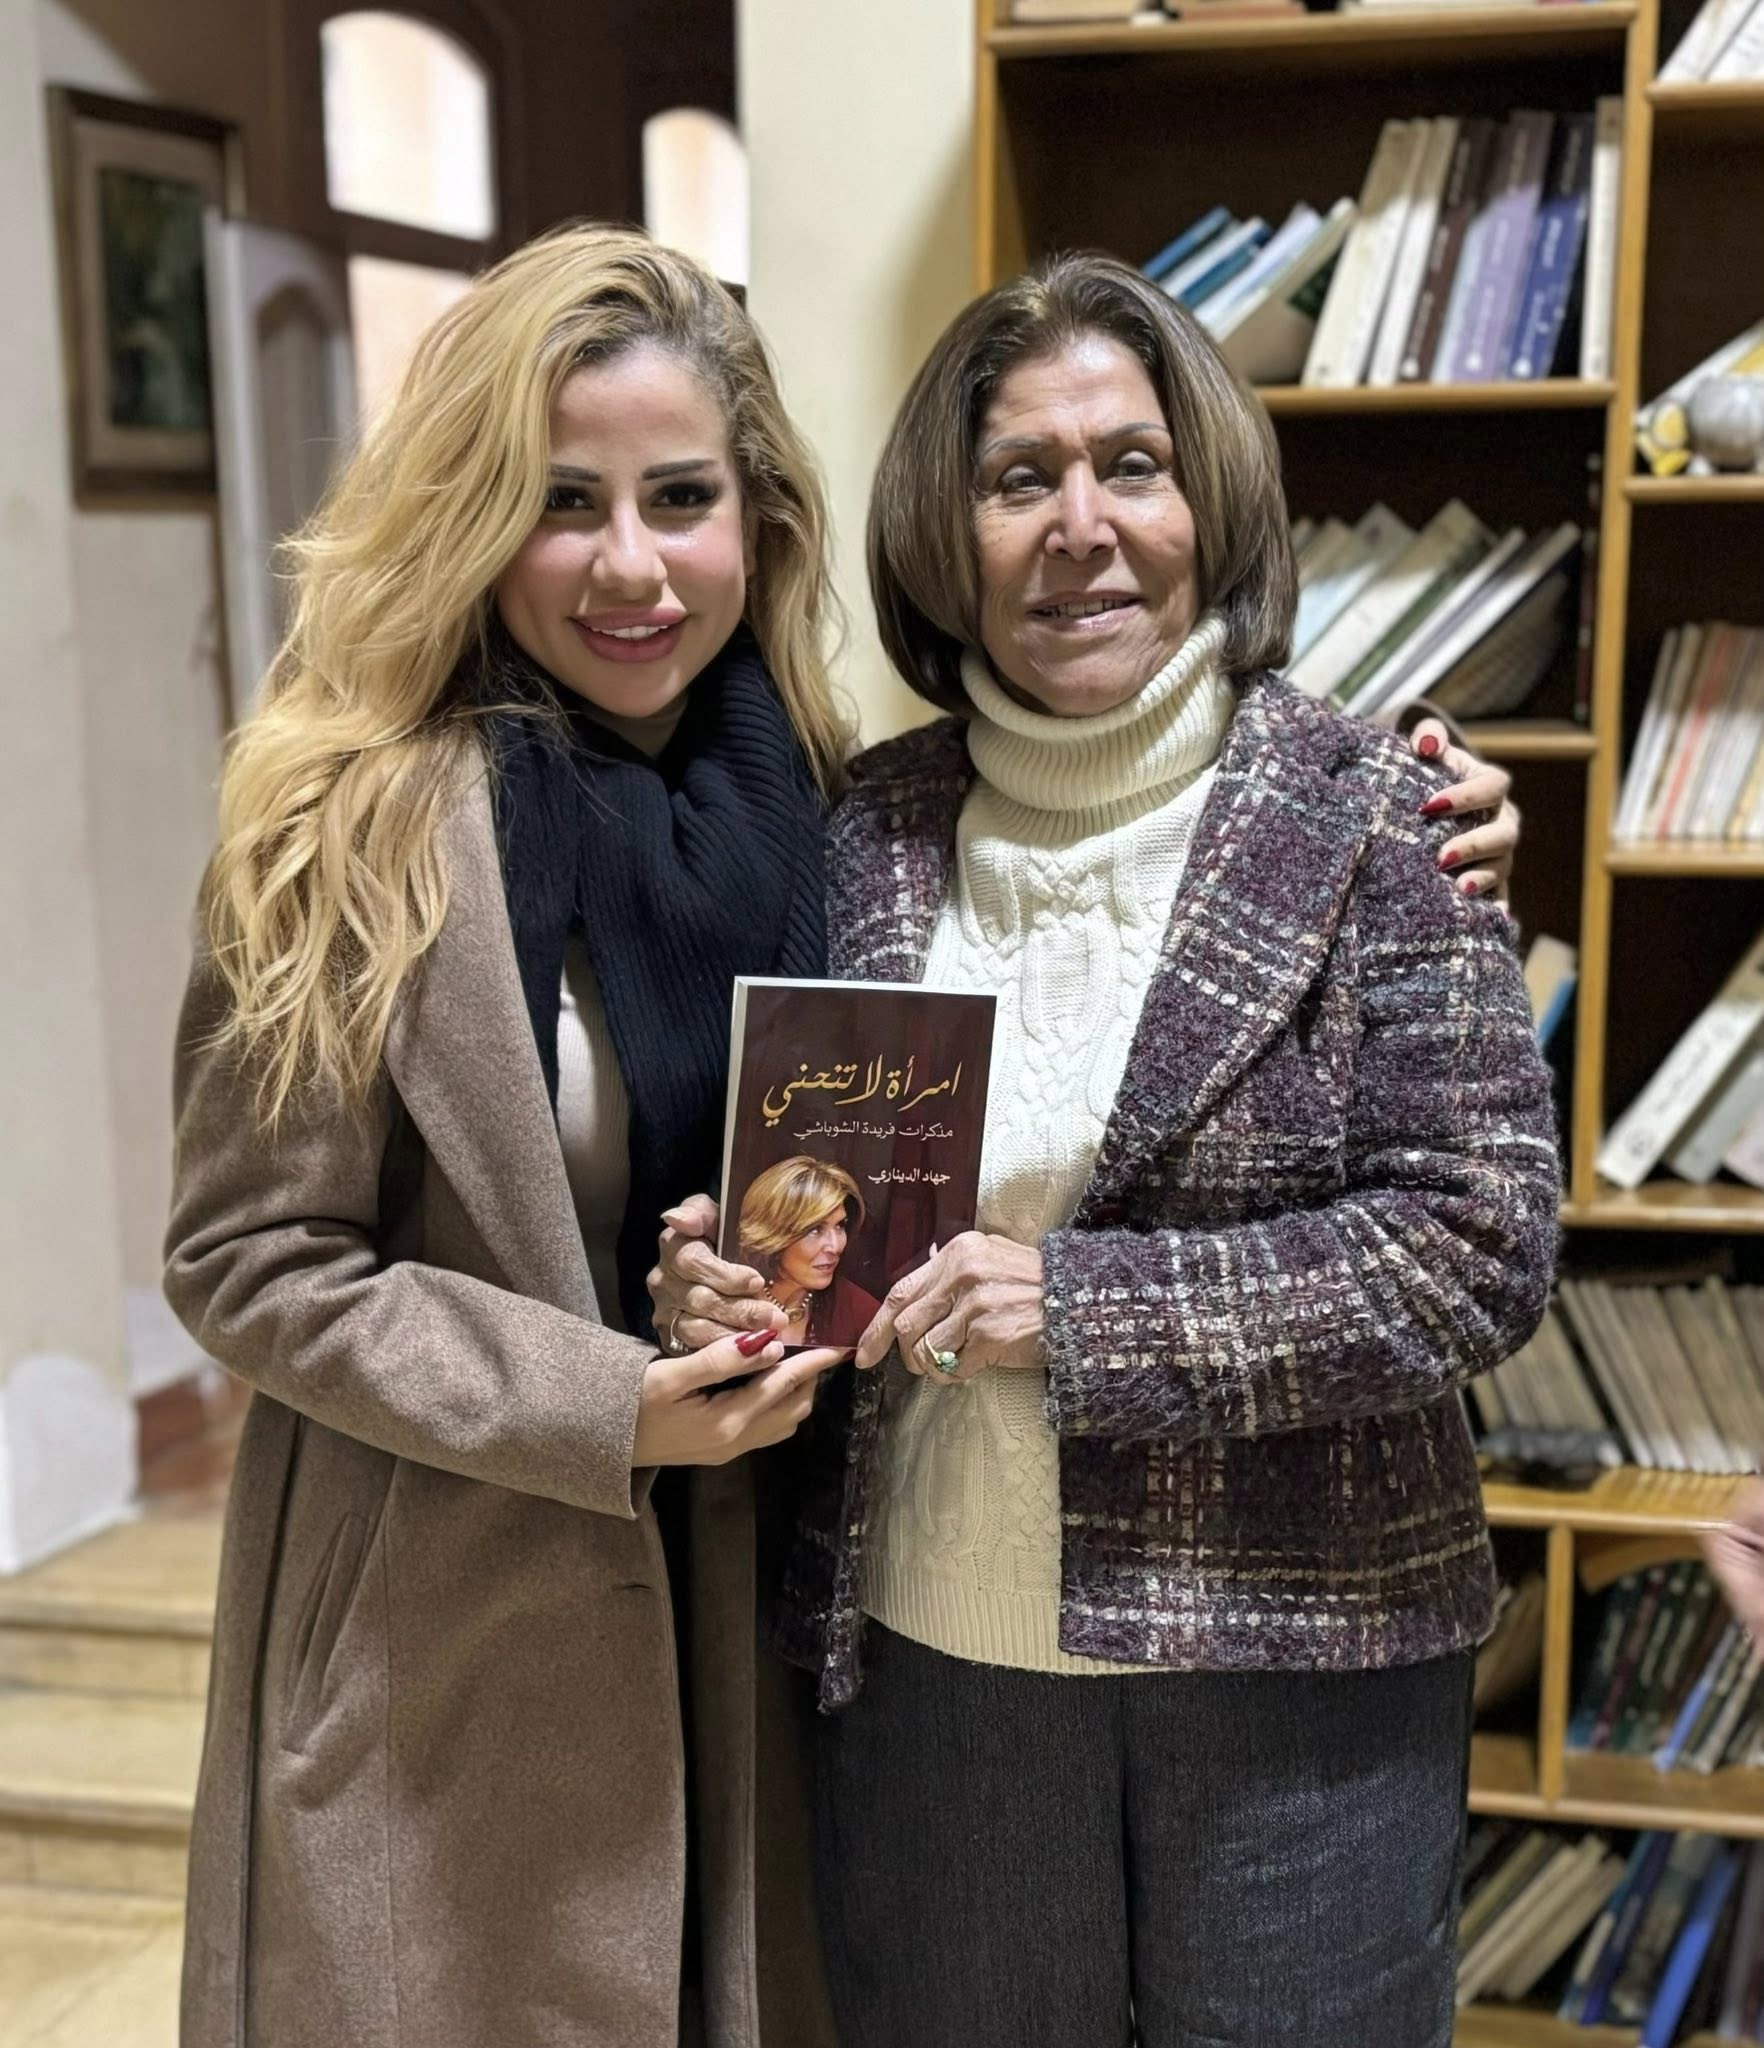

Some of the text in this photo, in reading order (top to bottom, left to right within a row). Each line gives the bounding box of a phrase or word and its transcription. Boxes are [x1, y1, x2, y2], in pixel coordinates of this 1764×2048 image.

[762, 1054, 962, 1128] امرأة لا تنحني
[793, 1120, 954, 1141] مذكرات فريدة الشوباشي
[868, 1168, 950, 1186] جهاد الديناري
